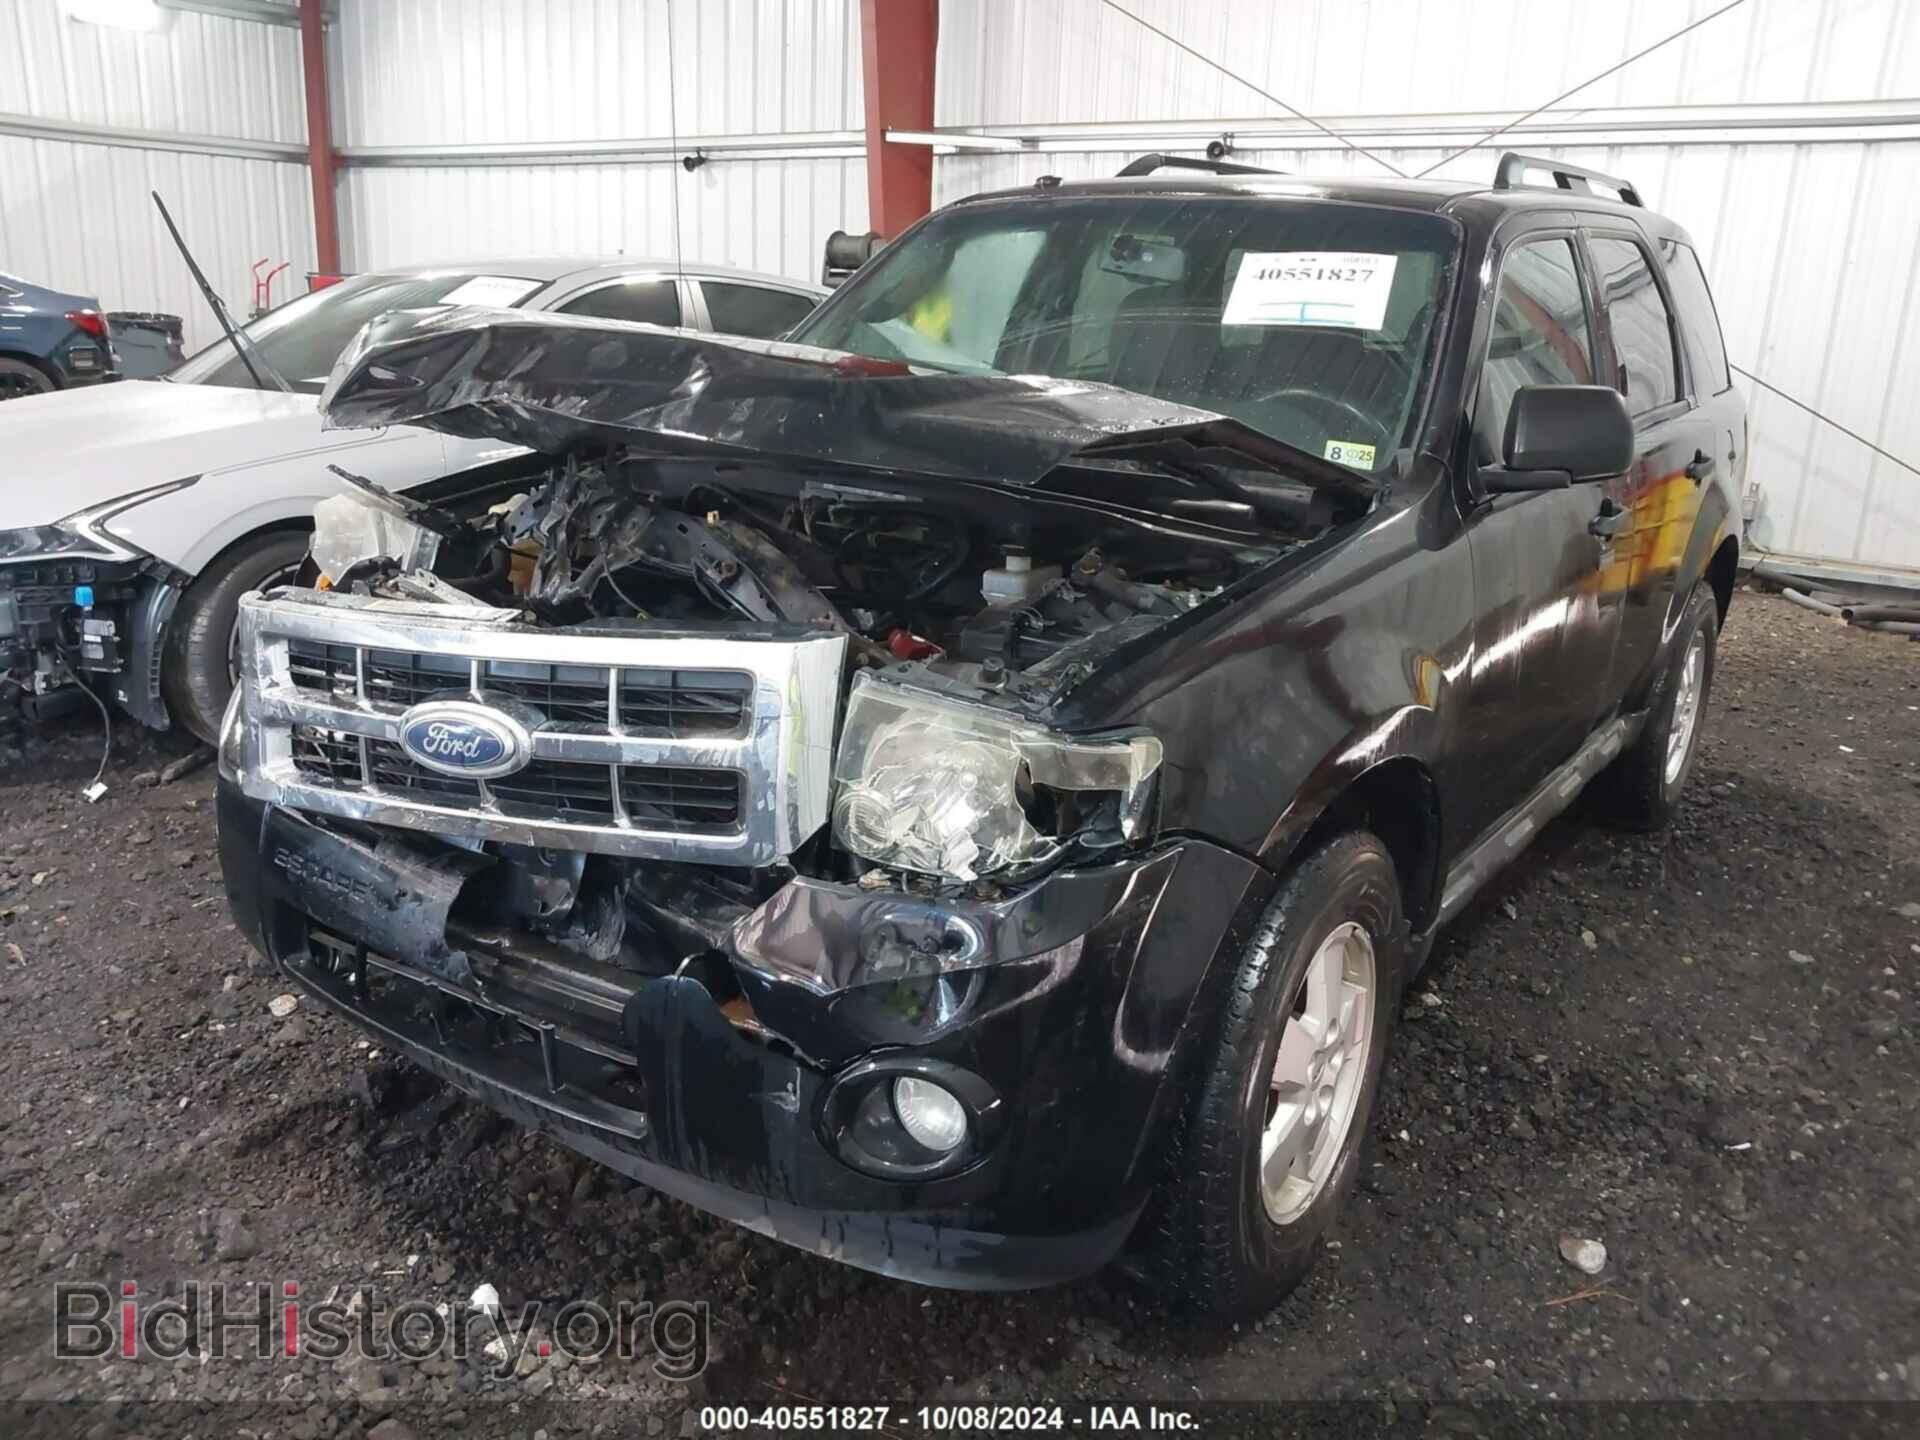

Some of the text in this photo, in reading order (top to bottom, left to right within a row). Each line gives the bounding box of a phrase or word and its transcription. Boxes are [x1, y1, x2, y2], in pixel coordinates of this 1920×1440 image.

[1252, 266, 1375, 283] 40551827
[1330, 446, 1342, 461] 8
[1359, 449, 1373, 462] 25
[423, 722, 482, 758] Ford
